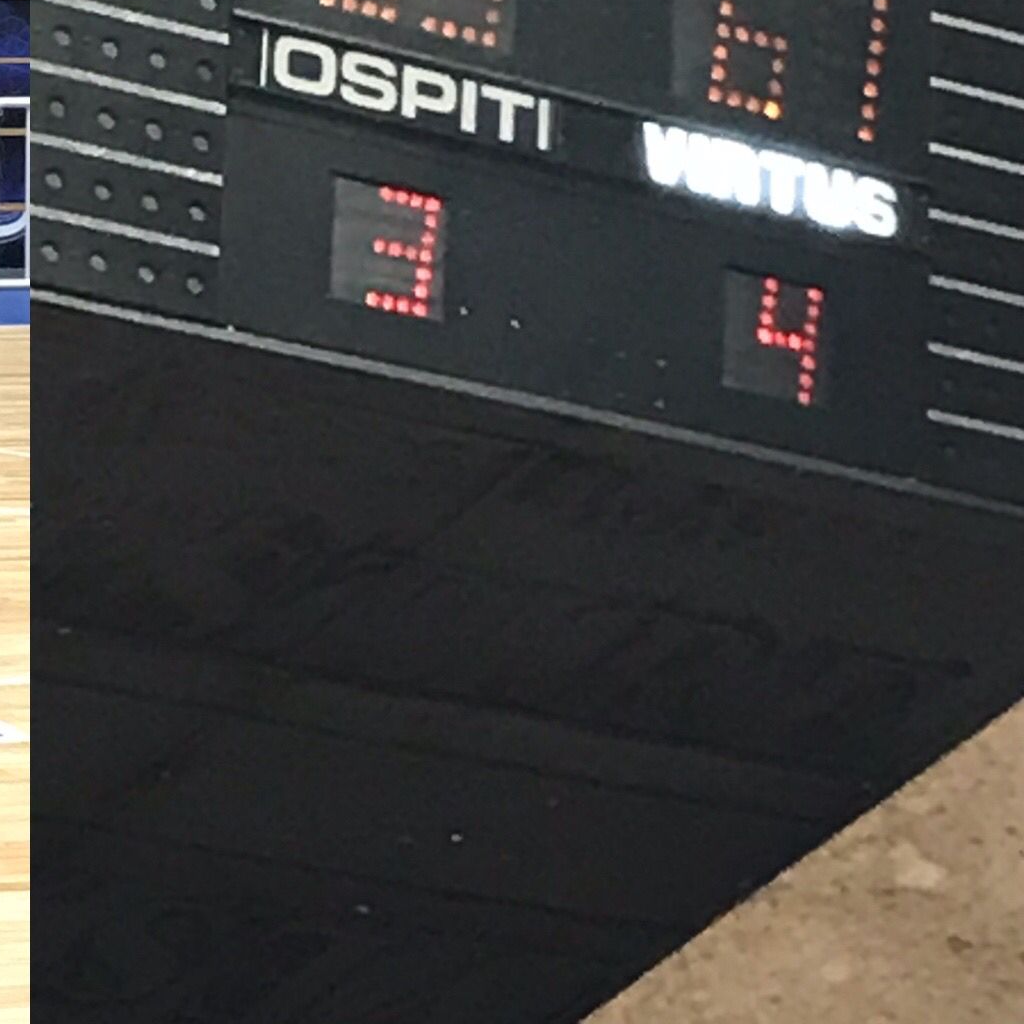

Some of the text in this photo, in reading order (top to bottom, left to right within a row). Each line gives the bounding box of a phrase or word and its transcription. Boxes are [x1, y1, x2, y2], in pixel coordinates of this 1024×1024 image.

[272, 34, 551, 151] OSPITI
[366, 185, 443, 318] 3
[757, 276, 825, 407] 4
